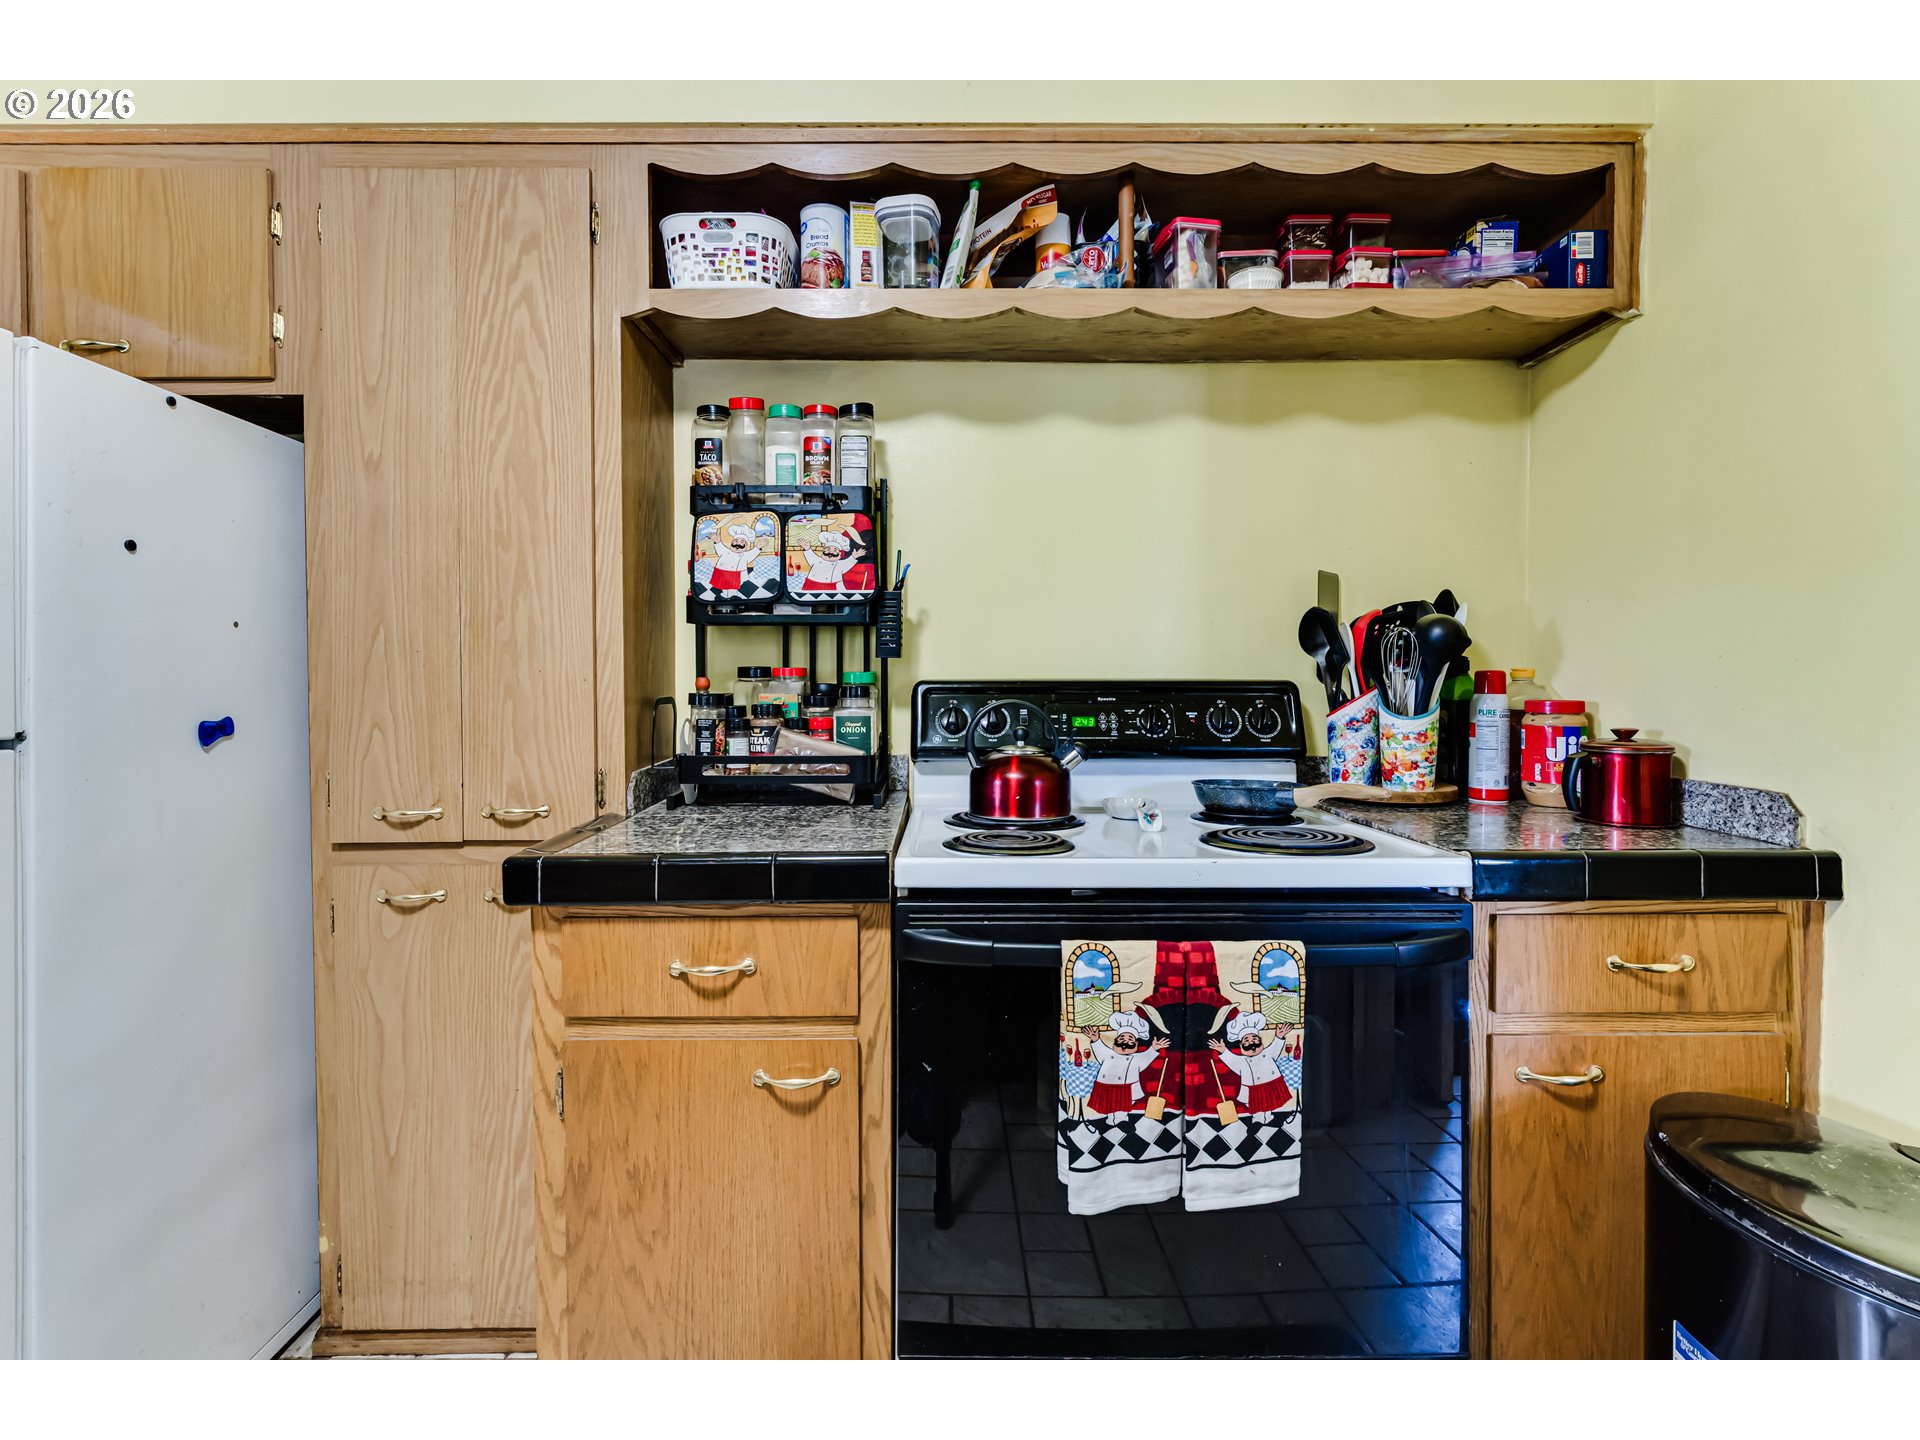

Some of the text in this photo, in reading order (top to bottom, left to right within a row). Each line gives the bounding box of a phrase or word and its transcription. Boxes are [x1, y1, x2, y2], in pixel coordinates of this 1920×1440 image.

[806, 240, 829, 248] Crumbs
[699, 453, 717, 462] TACO
[1478, 708, 1498, 716] PURE
